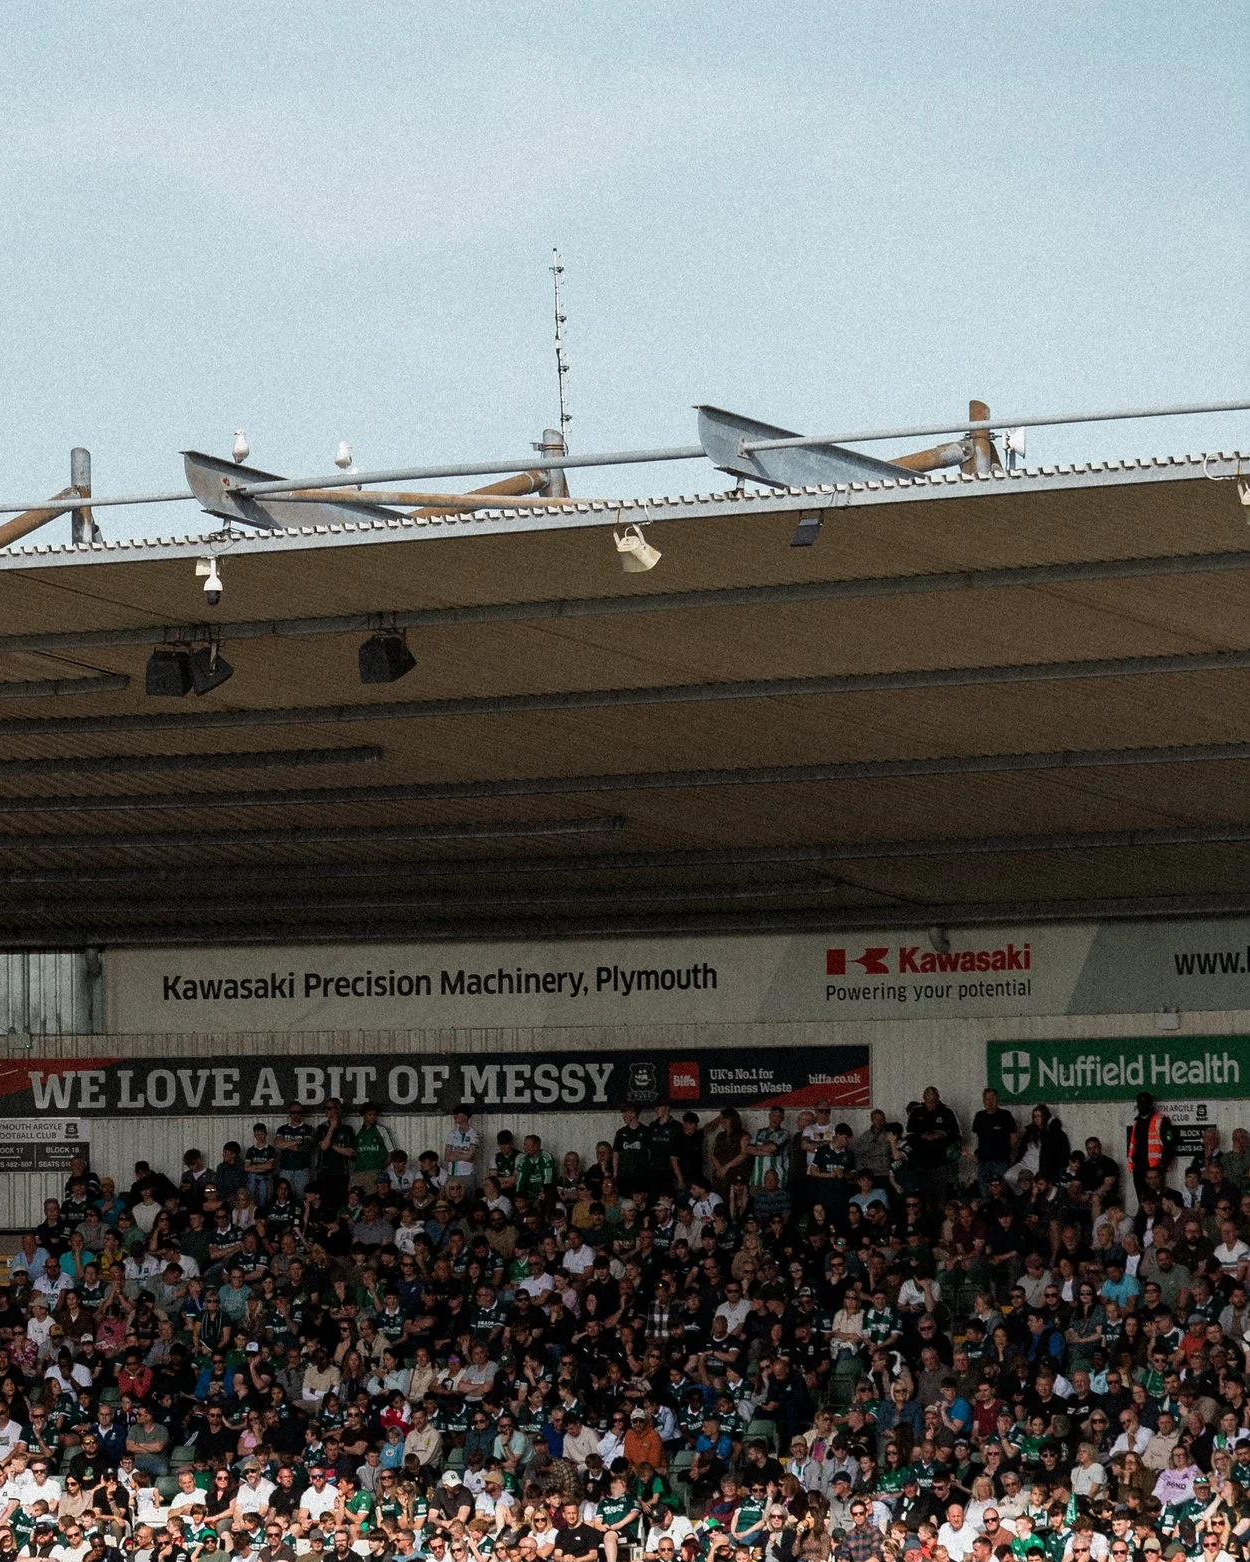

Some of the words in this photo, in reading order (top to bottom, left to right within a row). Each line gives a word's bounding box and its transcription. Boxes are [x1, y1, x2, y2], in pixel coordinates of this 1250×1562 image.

[899, 943, 1031, 974] Kawasaki
[163, 973, 296, 1000] Kawasaki
[305, 970, 432, 998] Precision
[441, 966, 589, 998] Machinery,
[596, 962, 718, 993] Plymouth
[826, 982, 907, 1002] Powering
[914, 984, 952, 1000] your
[959, 979, 1032, 1000] potential
[758, 1068, 774, 1079] for
[1038, 1055, 1144, 1087] Nuffield
[1150, 1052, 1240, 1084] Health
[28, 1070, 106, 1109] WE
[116, 1068, 240, 1109] LOVE
[252, 1068, 284, 1107] A
[294, 1066, 377, 1106] BIT
[387, 1065, 450, 1105] OF
[460, 1063, 614, 1104] MESSY
[673, 1075, 696, 1088] Biffa
[710, 1082, 758, 1094] Business
[760, 1082, 792, 1094] Waste
[808, 1073, 861, 1085] biffa.co.uk
[33, 1123, 62, 1131] ARGYLE
